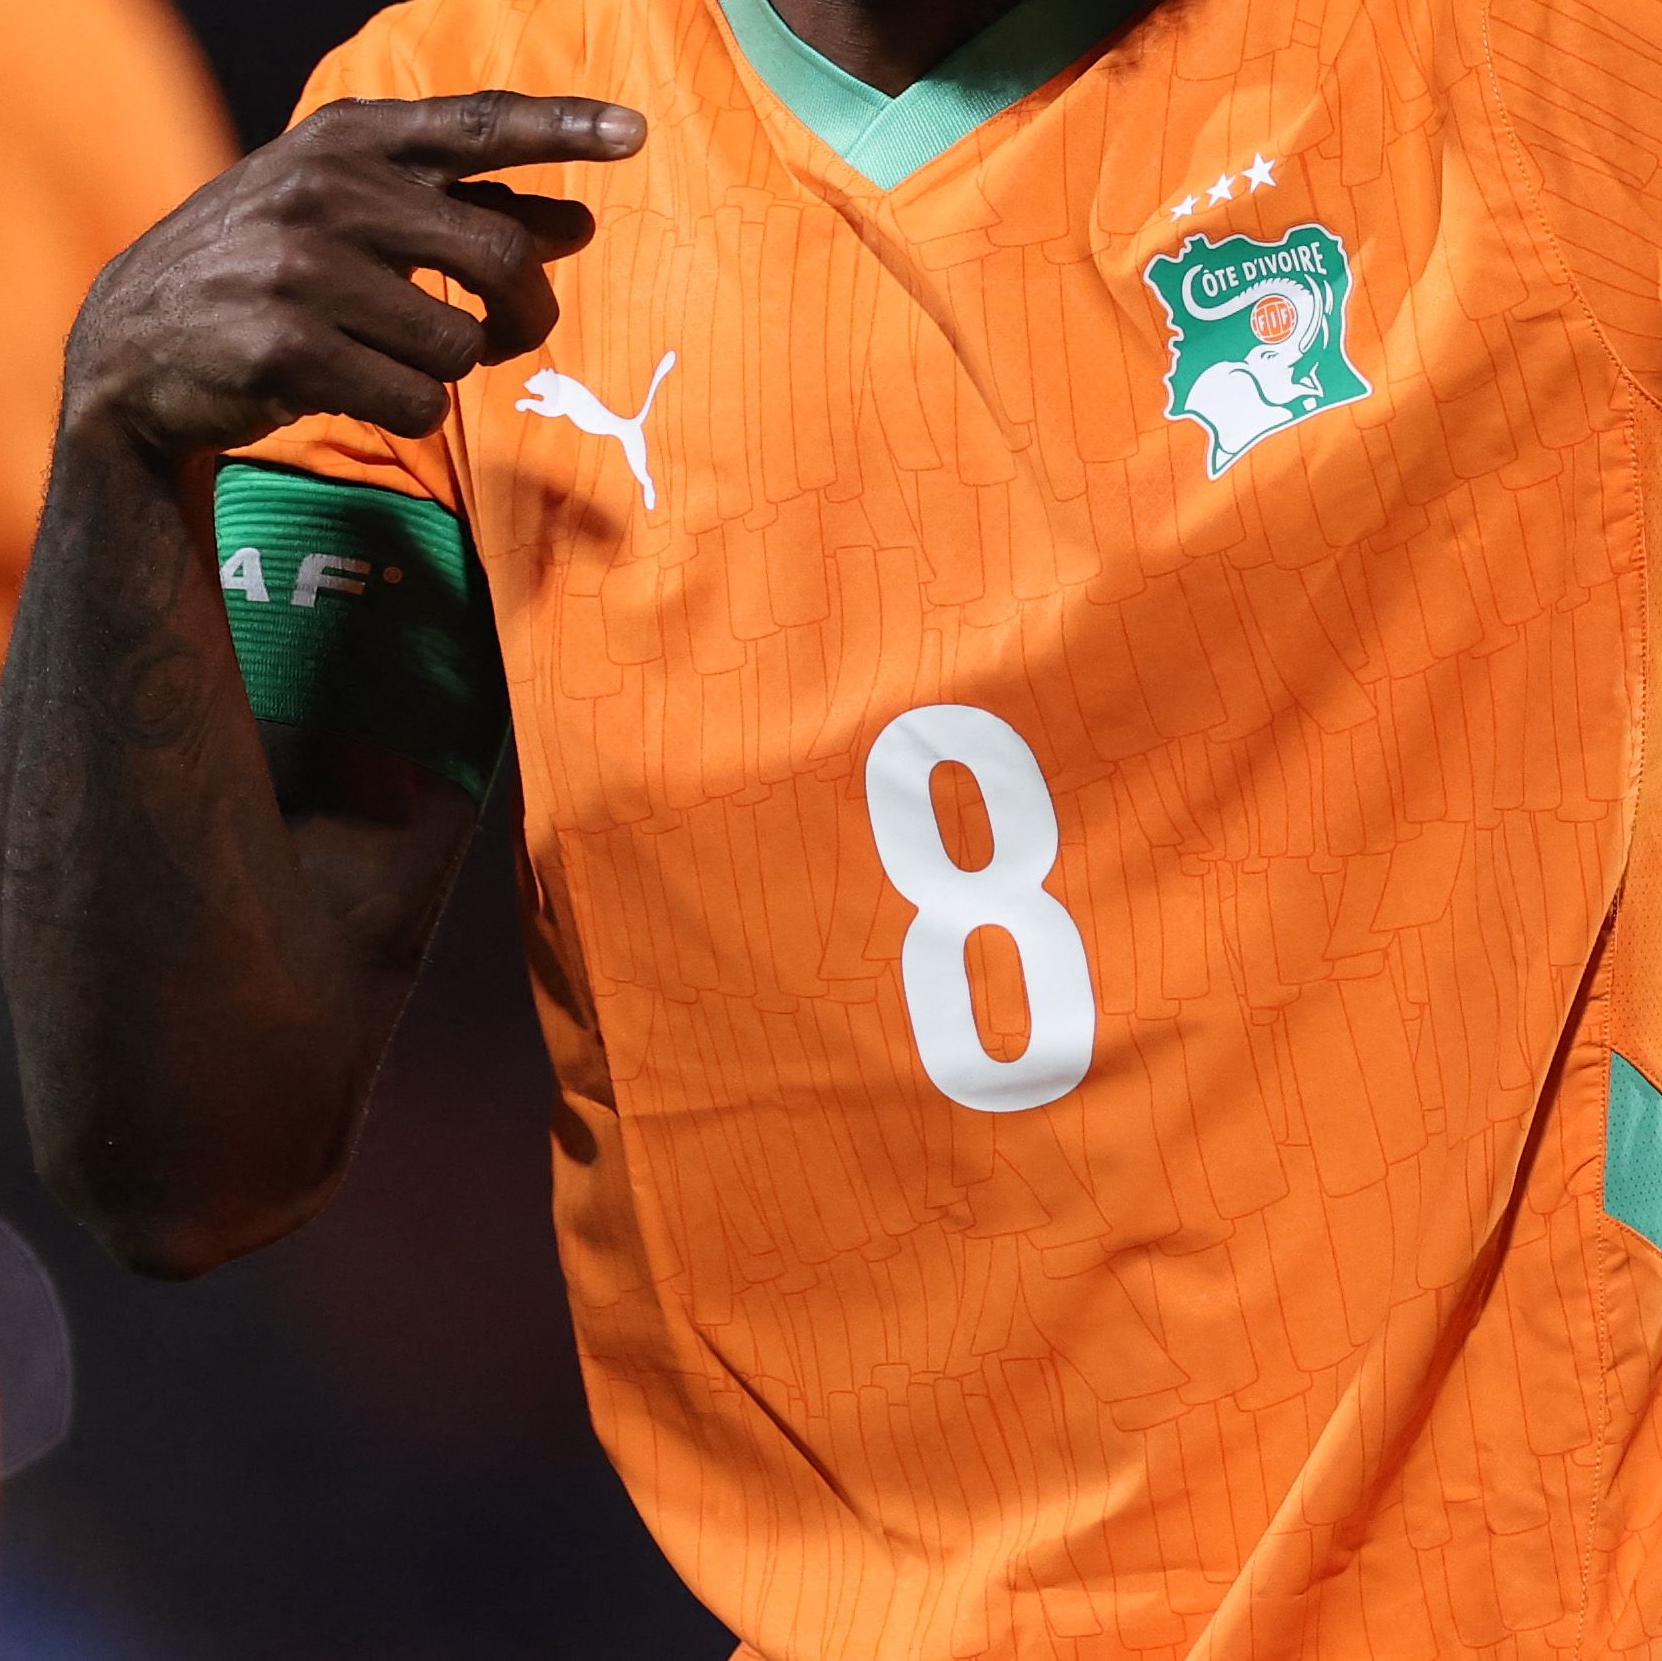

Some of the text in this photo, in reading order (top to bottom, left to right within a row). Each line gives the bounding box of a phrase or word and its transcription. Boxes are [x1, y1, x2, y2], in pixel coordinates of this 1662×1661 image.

[1242, 242, 1327, 282] D'IVOIRE
[1256, 308, 1290, 332] FIF
[865, 704, 1097, 1113] 8
